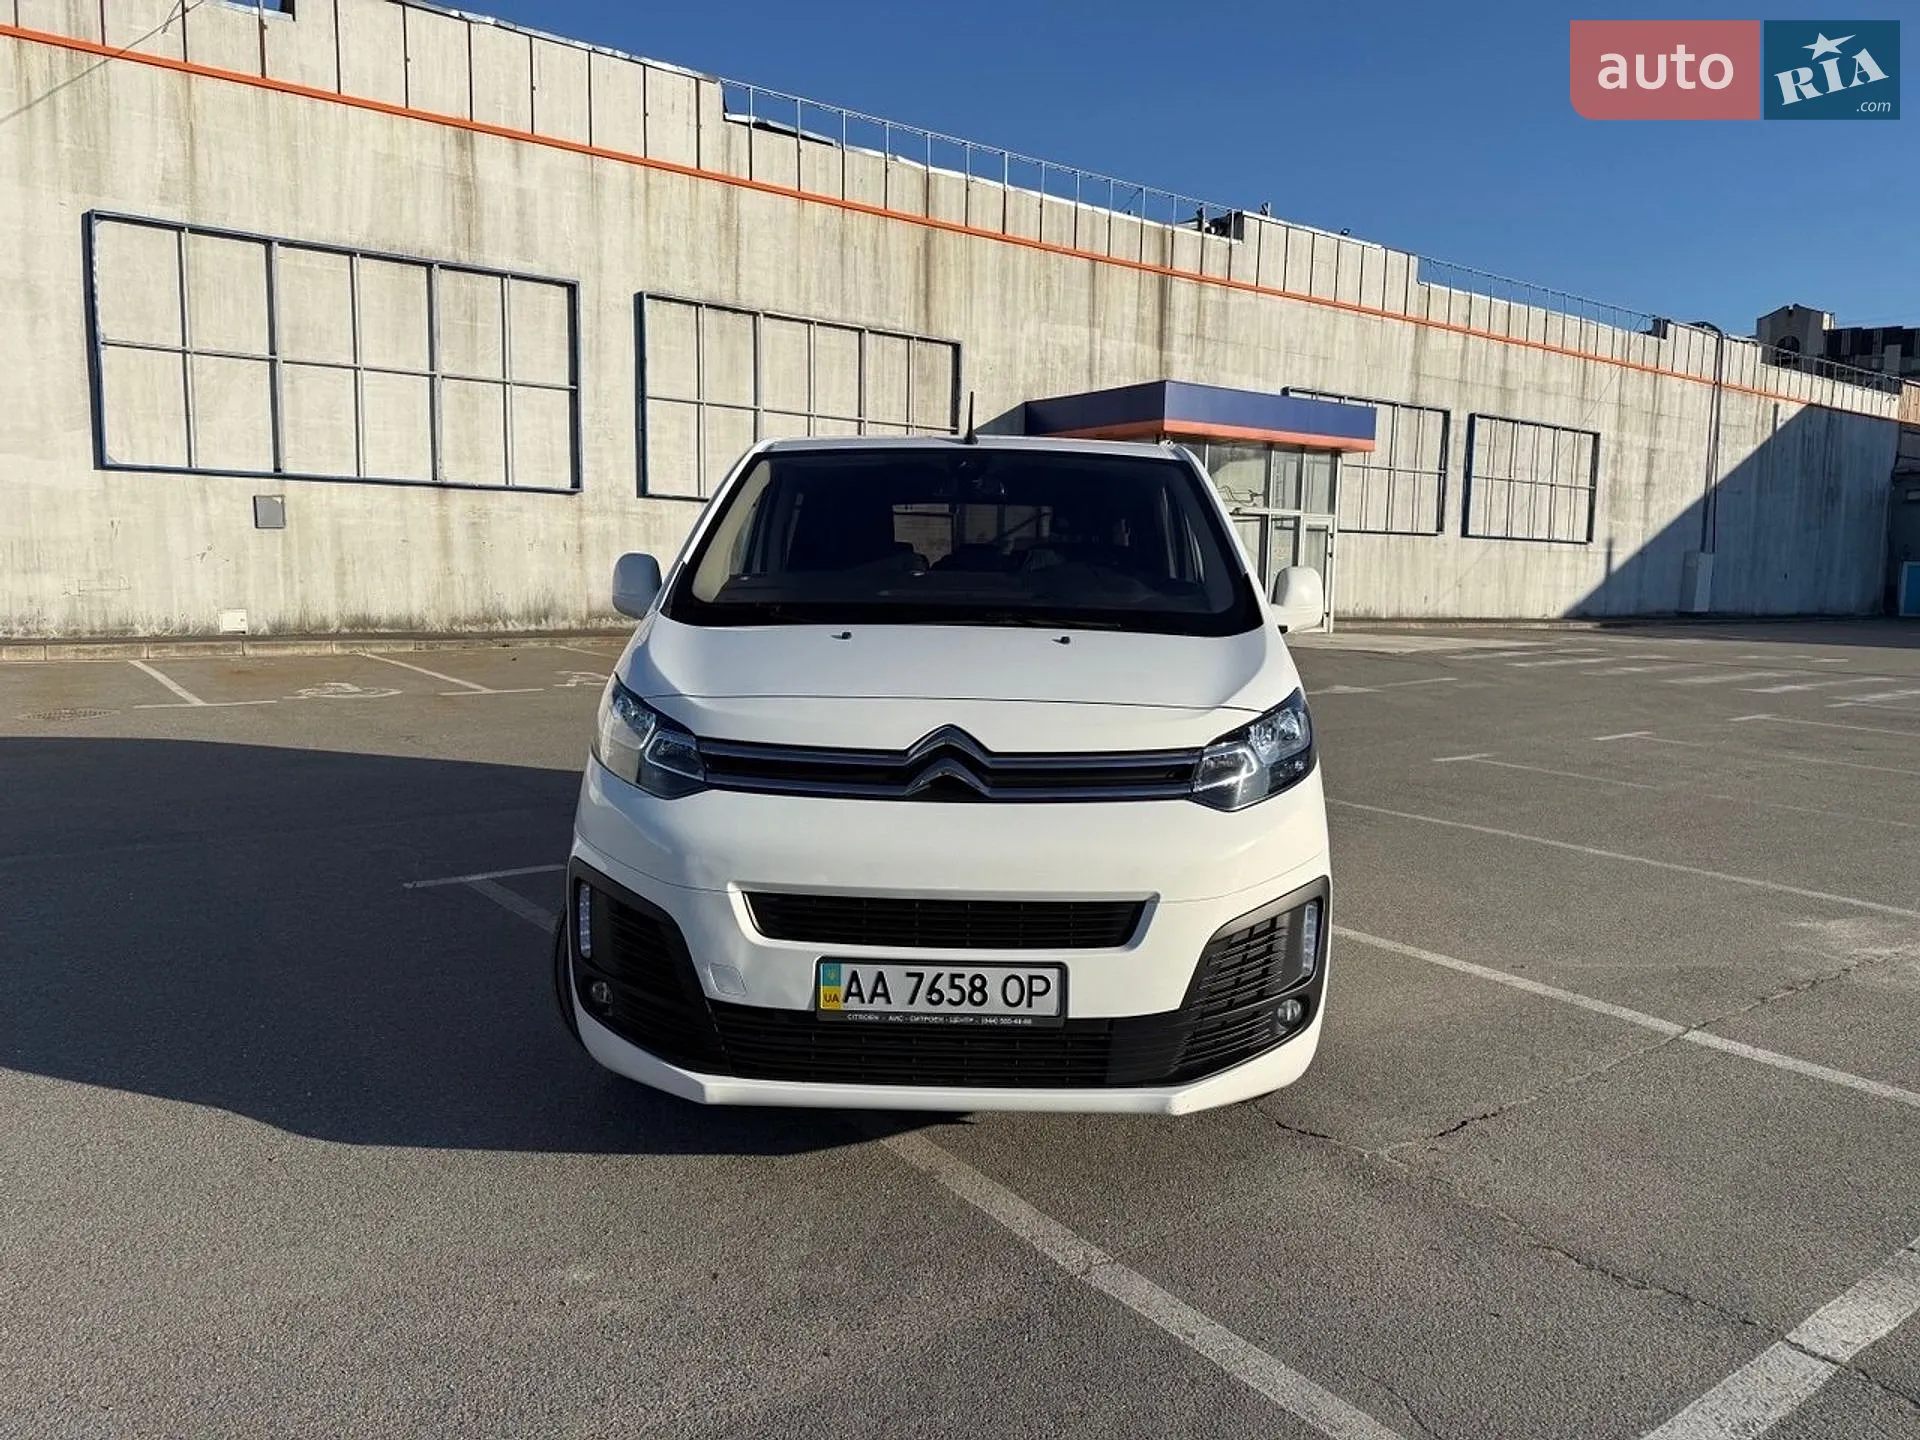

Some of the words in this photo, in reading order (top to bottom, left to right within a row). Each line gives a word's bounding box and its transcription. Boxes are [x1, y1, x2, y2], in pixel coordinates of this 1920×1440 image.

[823, 993, 840, 1003] UA
[843, 970, 893, 1005] AA
[905, 972, 989, 1007] 7658
[1001, 974, 1052, 1008] OP
